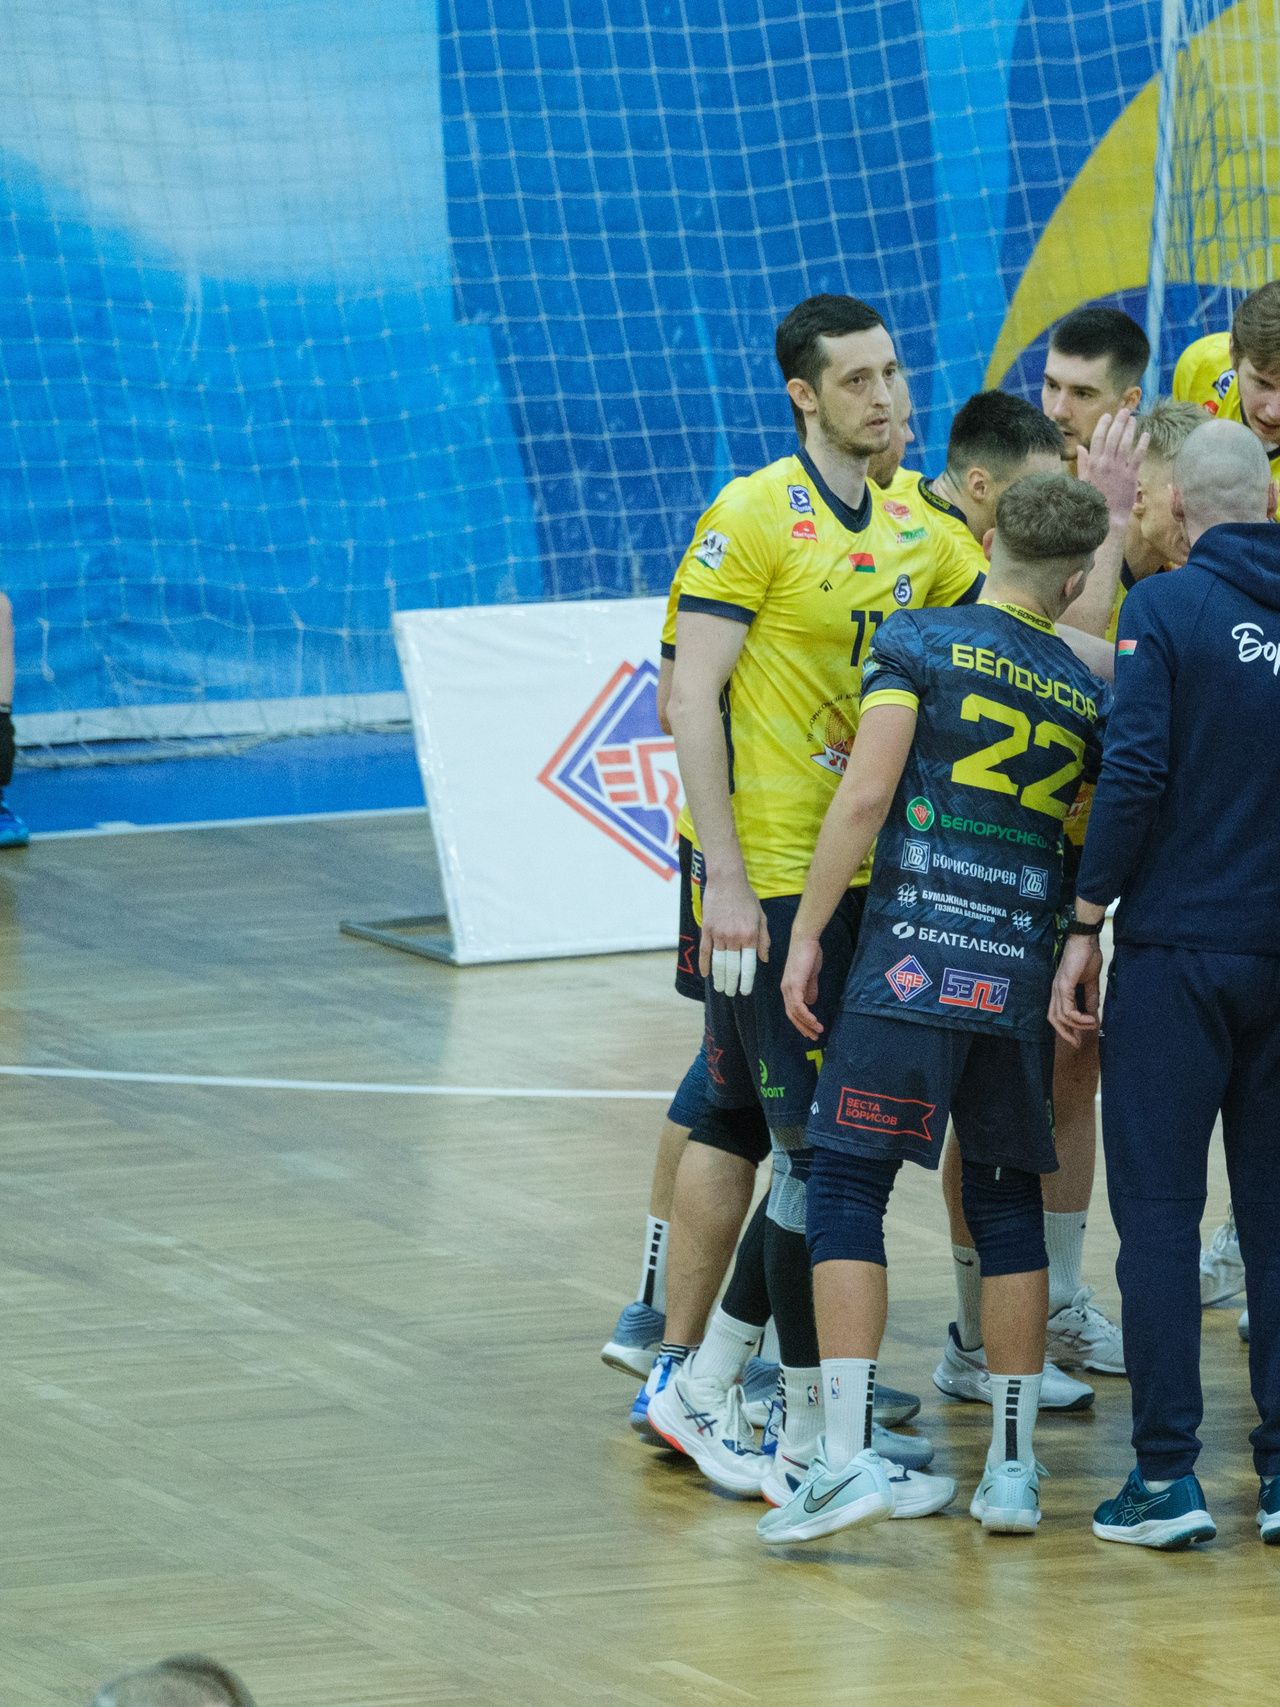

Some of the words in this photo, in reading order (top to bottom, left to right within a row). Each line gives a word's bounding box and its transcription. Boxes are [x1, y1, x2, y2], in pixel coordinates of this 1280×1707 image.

[952, 643, 1099, 724] БЕЛОУСОВ
[951, 693, 1086, 821] 22
[940, 814, 1048, 849] БЕЛОРУСНЕФ
[922, 890, 969, 909] БУМАЖНАЯ
[969, 902, 1007, 918] ФАБРИКА
[934, 903, 964, 916] ГОЗНАКА
[964, 910, 996, 923] БЕЛАРУСИ
[918, 927, 1025, 959] БЕЛТЕЛЕКОМ
[845, 1107, 898, 1126] БОРИСОВ
[846, 1097, 881, 1112] ВЕСТА
